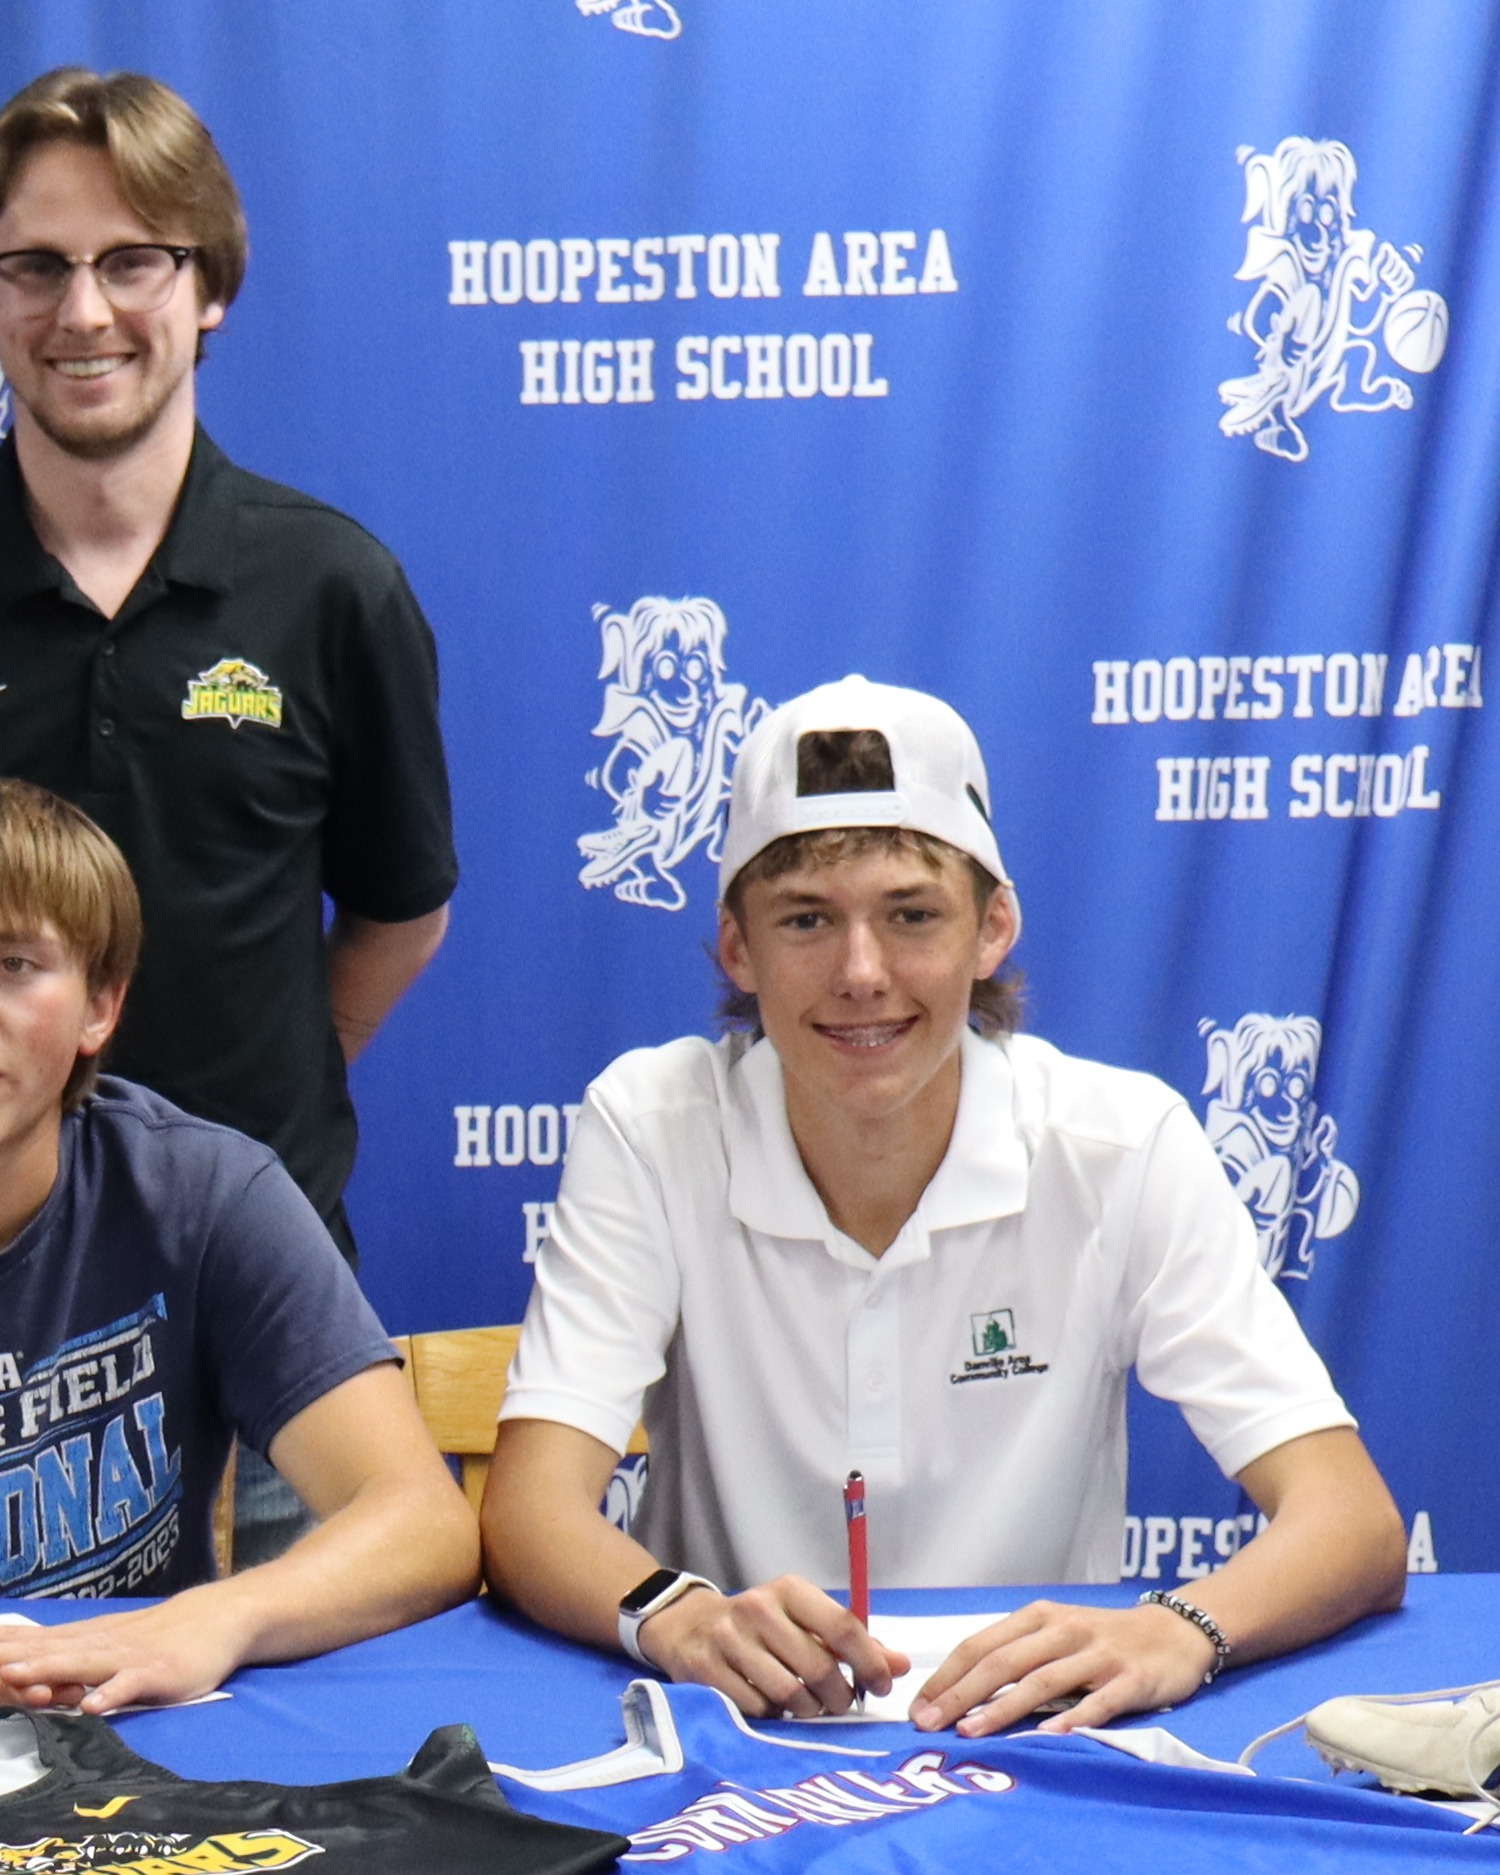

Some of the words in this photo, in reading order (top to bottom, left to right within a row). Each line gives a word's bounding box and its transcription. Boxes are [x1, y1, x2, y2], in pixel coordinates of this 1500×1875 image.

[448, 233, 782, 305] HOOPESTON
[804, 228, 959, 297] AREA
[520, 338, 653, 406] HIGH
[676, 333, 889, 401] SCHOOL
[184, 684, 283, 722] JAGUARS
[1091, 652, 1389, 724] HOOPESTON
[1393, 642, 1483, 718] AREA
[1154, 756, 1271, 822] HIGH
[20, 1333, 157, 1439] FIELD
